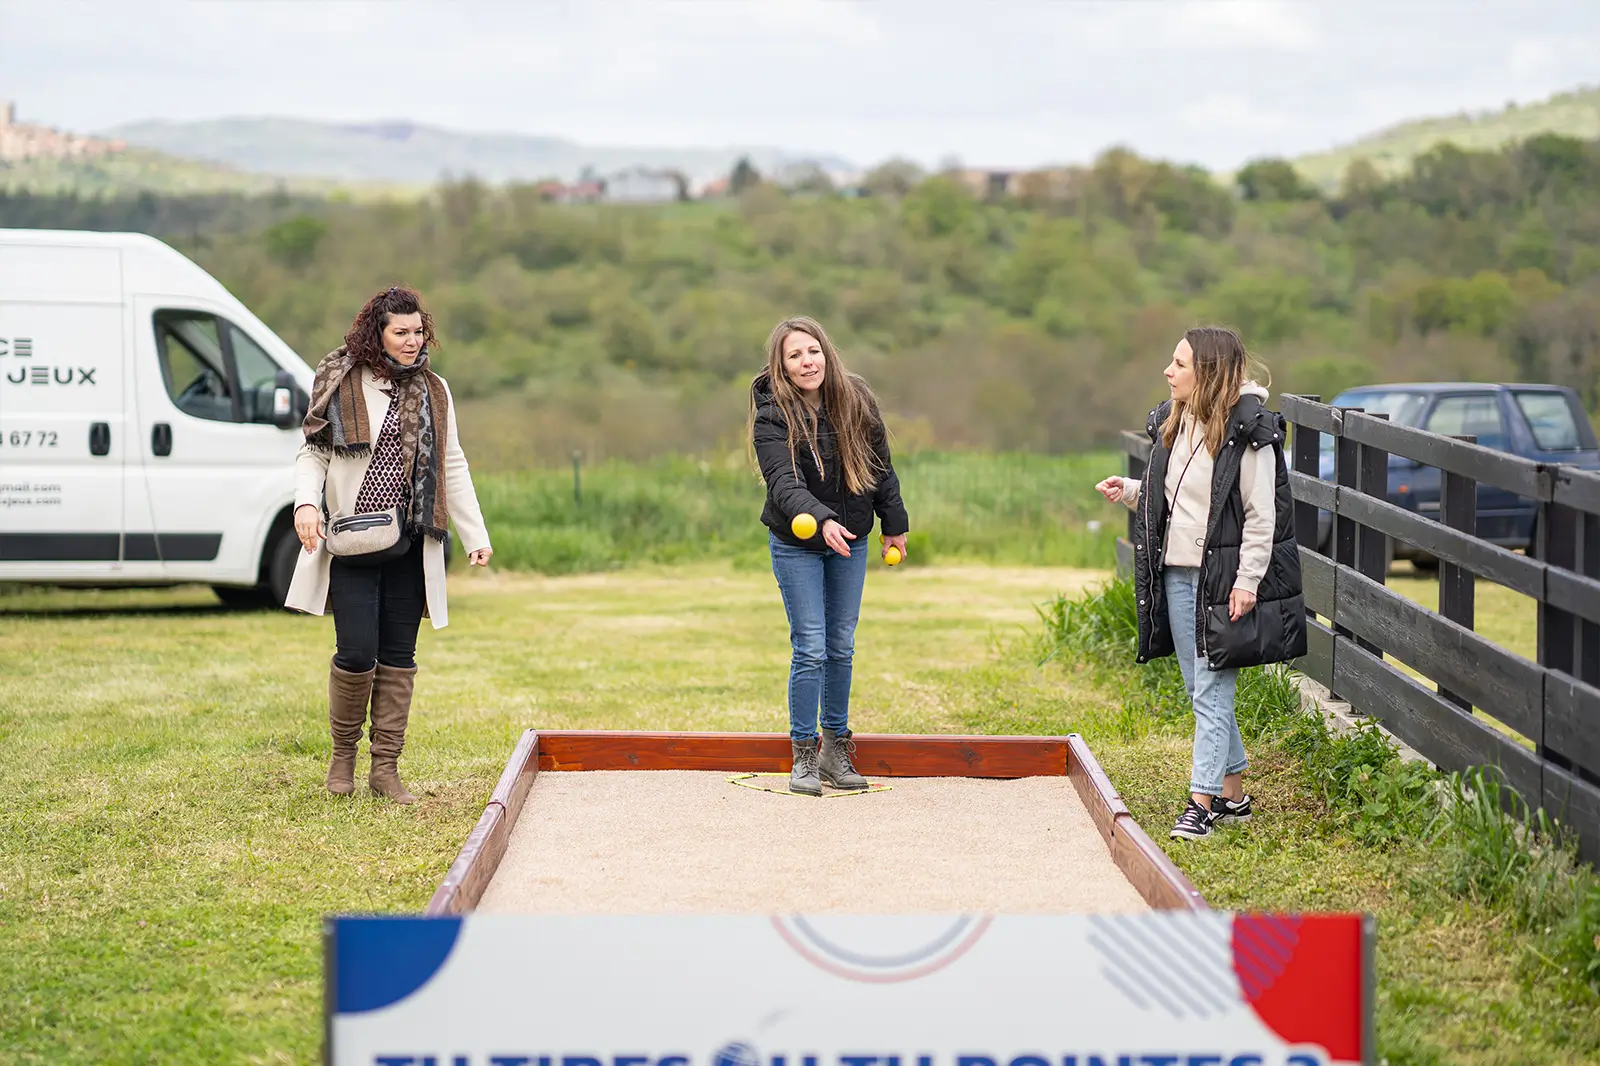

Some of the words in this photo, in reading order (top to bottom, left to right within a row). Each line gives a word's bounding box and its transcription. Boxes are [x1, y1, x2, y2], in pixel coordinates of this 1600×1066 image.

[7, 366, 96, 385] JEUX
[10, 430, 32, 447] 67
[38, 430, 58, 447] 72
